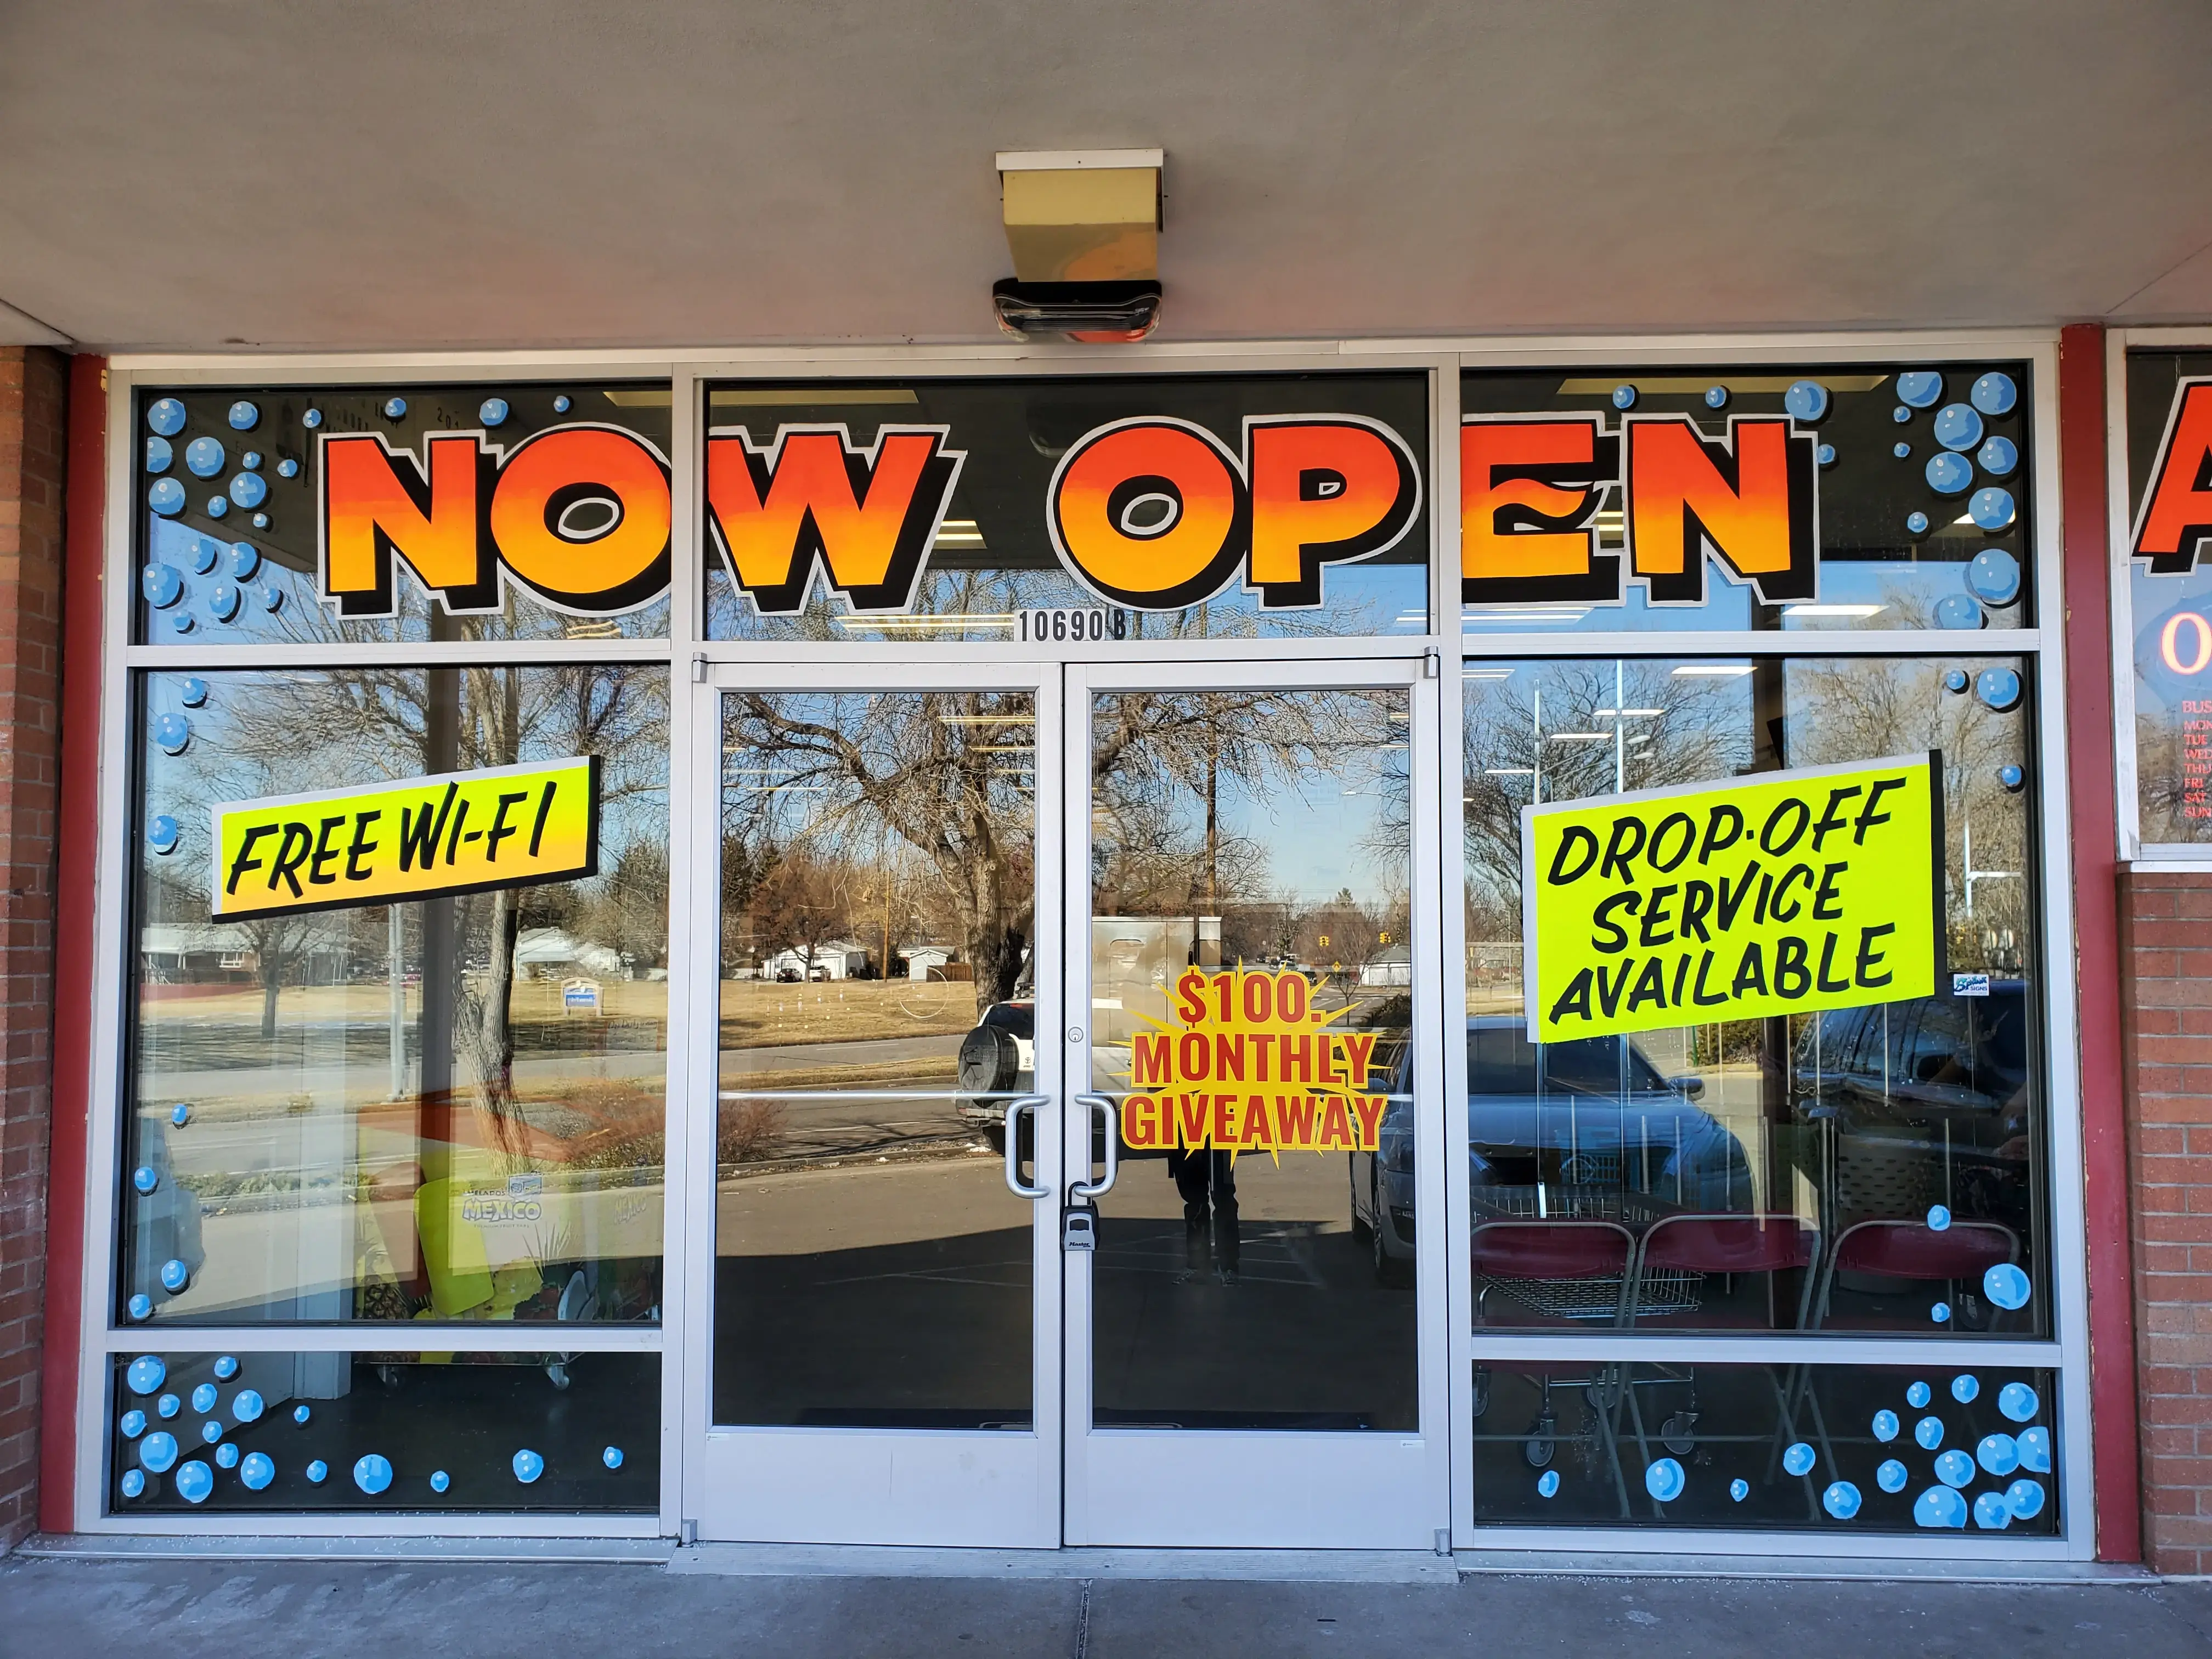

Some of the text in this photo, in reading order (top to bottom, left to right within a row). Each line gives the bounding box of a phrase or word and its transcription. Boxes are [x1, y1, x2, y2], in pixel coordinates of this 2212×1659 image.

[318, 411, 1819, 619] NOW OPEN
[1019, 609, 1125, 641] 10690 B
[2184, 733, 2208, 745] TUE
[2184, 748, 2212, 760] WED
[2184, 763, 2211, 774] THU
[2184, 778, 2203, 788] FRI
[2184, 793, 2208, 803] SAT
[2184, 806, 2211, 817] SUN
[226, 781, 557, 899] FREE WI-FI
[1592, 860, 1848, 953] SERVICE
[1549, 922, 1895, 1025] AVAILABLE
[1134, 1032, 1374, 1084] MONTHLY
[1125, 1094, 1386, 1146] GIVEAWAY
[462, 1197, 542, 1222] MEXICO
